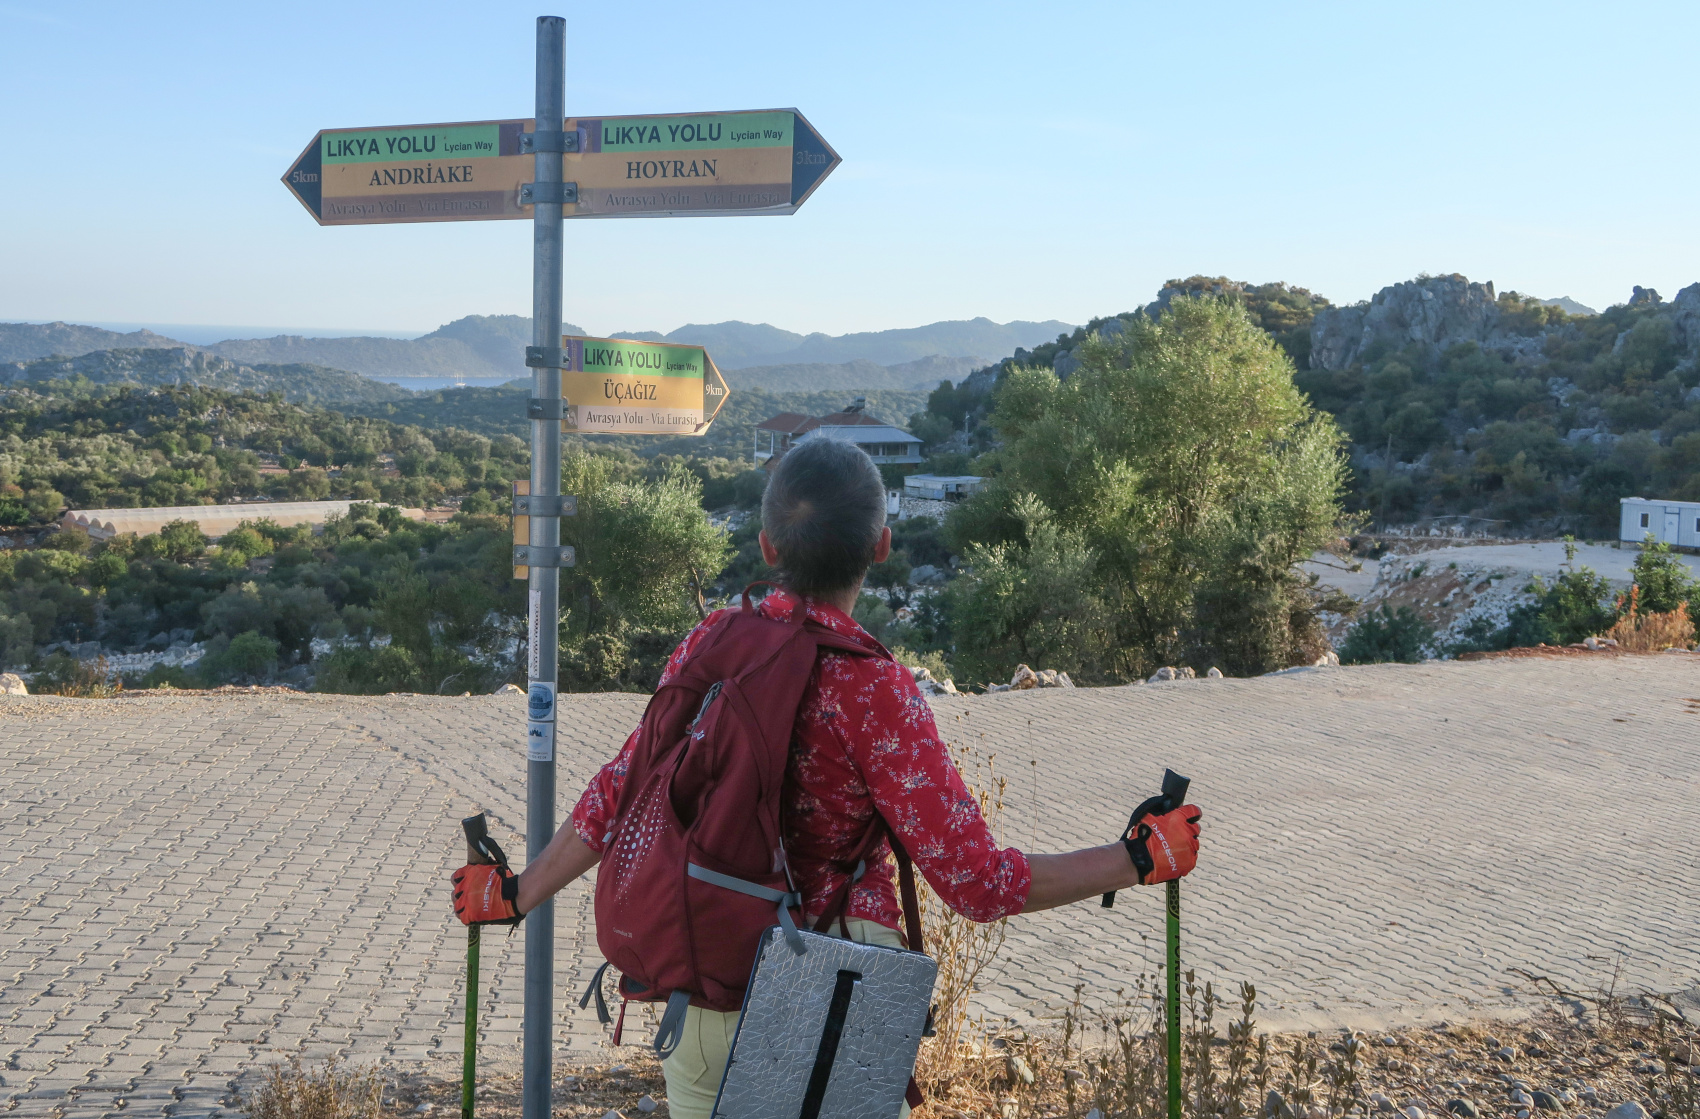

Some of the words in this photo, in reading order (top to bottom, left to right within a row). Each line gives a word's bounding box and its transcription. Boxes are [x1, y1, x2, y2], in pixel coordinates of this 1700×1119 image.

[668, 122, 722, 143] YOLU
[730, 131, 761, 143] Lycian
[763, 130, 783, 141] Way
[386, 135, 436, 154] YOLU
[444, 142, 472, 153] Lycian
[474, 141, 493, 151] Way
[796, 150, 827, 165] 3km
[292, 170, 318, 183] 5km
[369, 163, 474, 186] ANDRİAKE
[626, 159, 717, 179] HOYRAN
[328, 202, 375, 216] Avrasya
[378, 199, 406, 213] Yolu
[418, 199, 438, 212] Via
[442, 198, 490, 211] Eurasia
[605, 193, 656, 207] Avrasya
[660, 191, 690, 205] Yolu
[704, 191, 724, 204] Via
[729, 190, 780, 204] Eurasia
[628, 350, 662, 369] YOLU
[666, 361, 685, 372] Lycian
[685, 362, 698, 373] Way
[603, 379, 657, 404] ÜÇAĞIZ
[705, 384, 723, 396] 9km
[586, 411, 621, 429] Avrasya
[623, 412, 643, 425] Yolu
[651, 413, 665, 426] Via
[667, 413, 698, 426] Eurasia
[1152, 823, 1178, 871] NORDSKI
